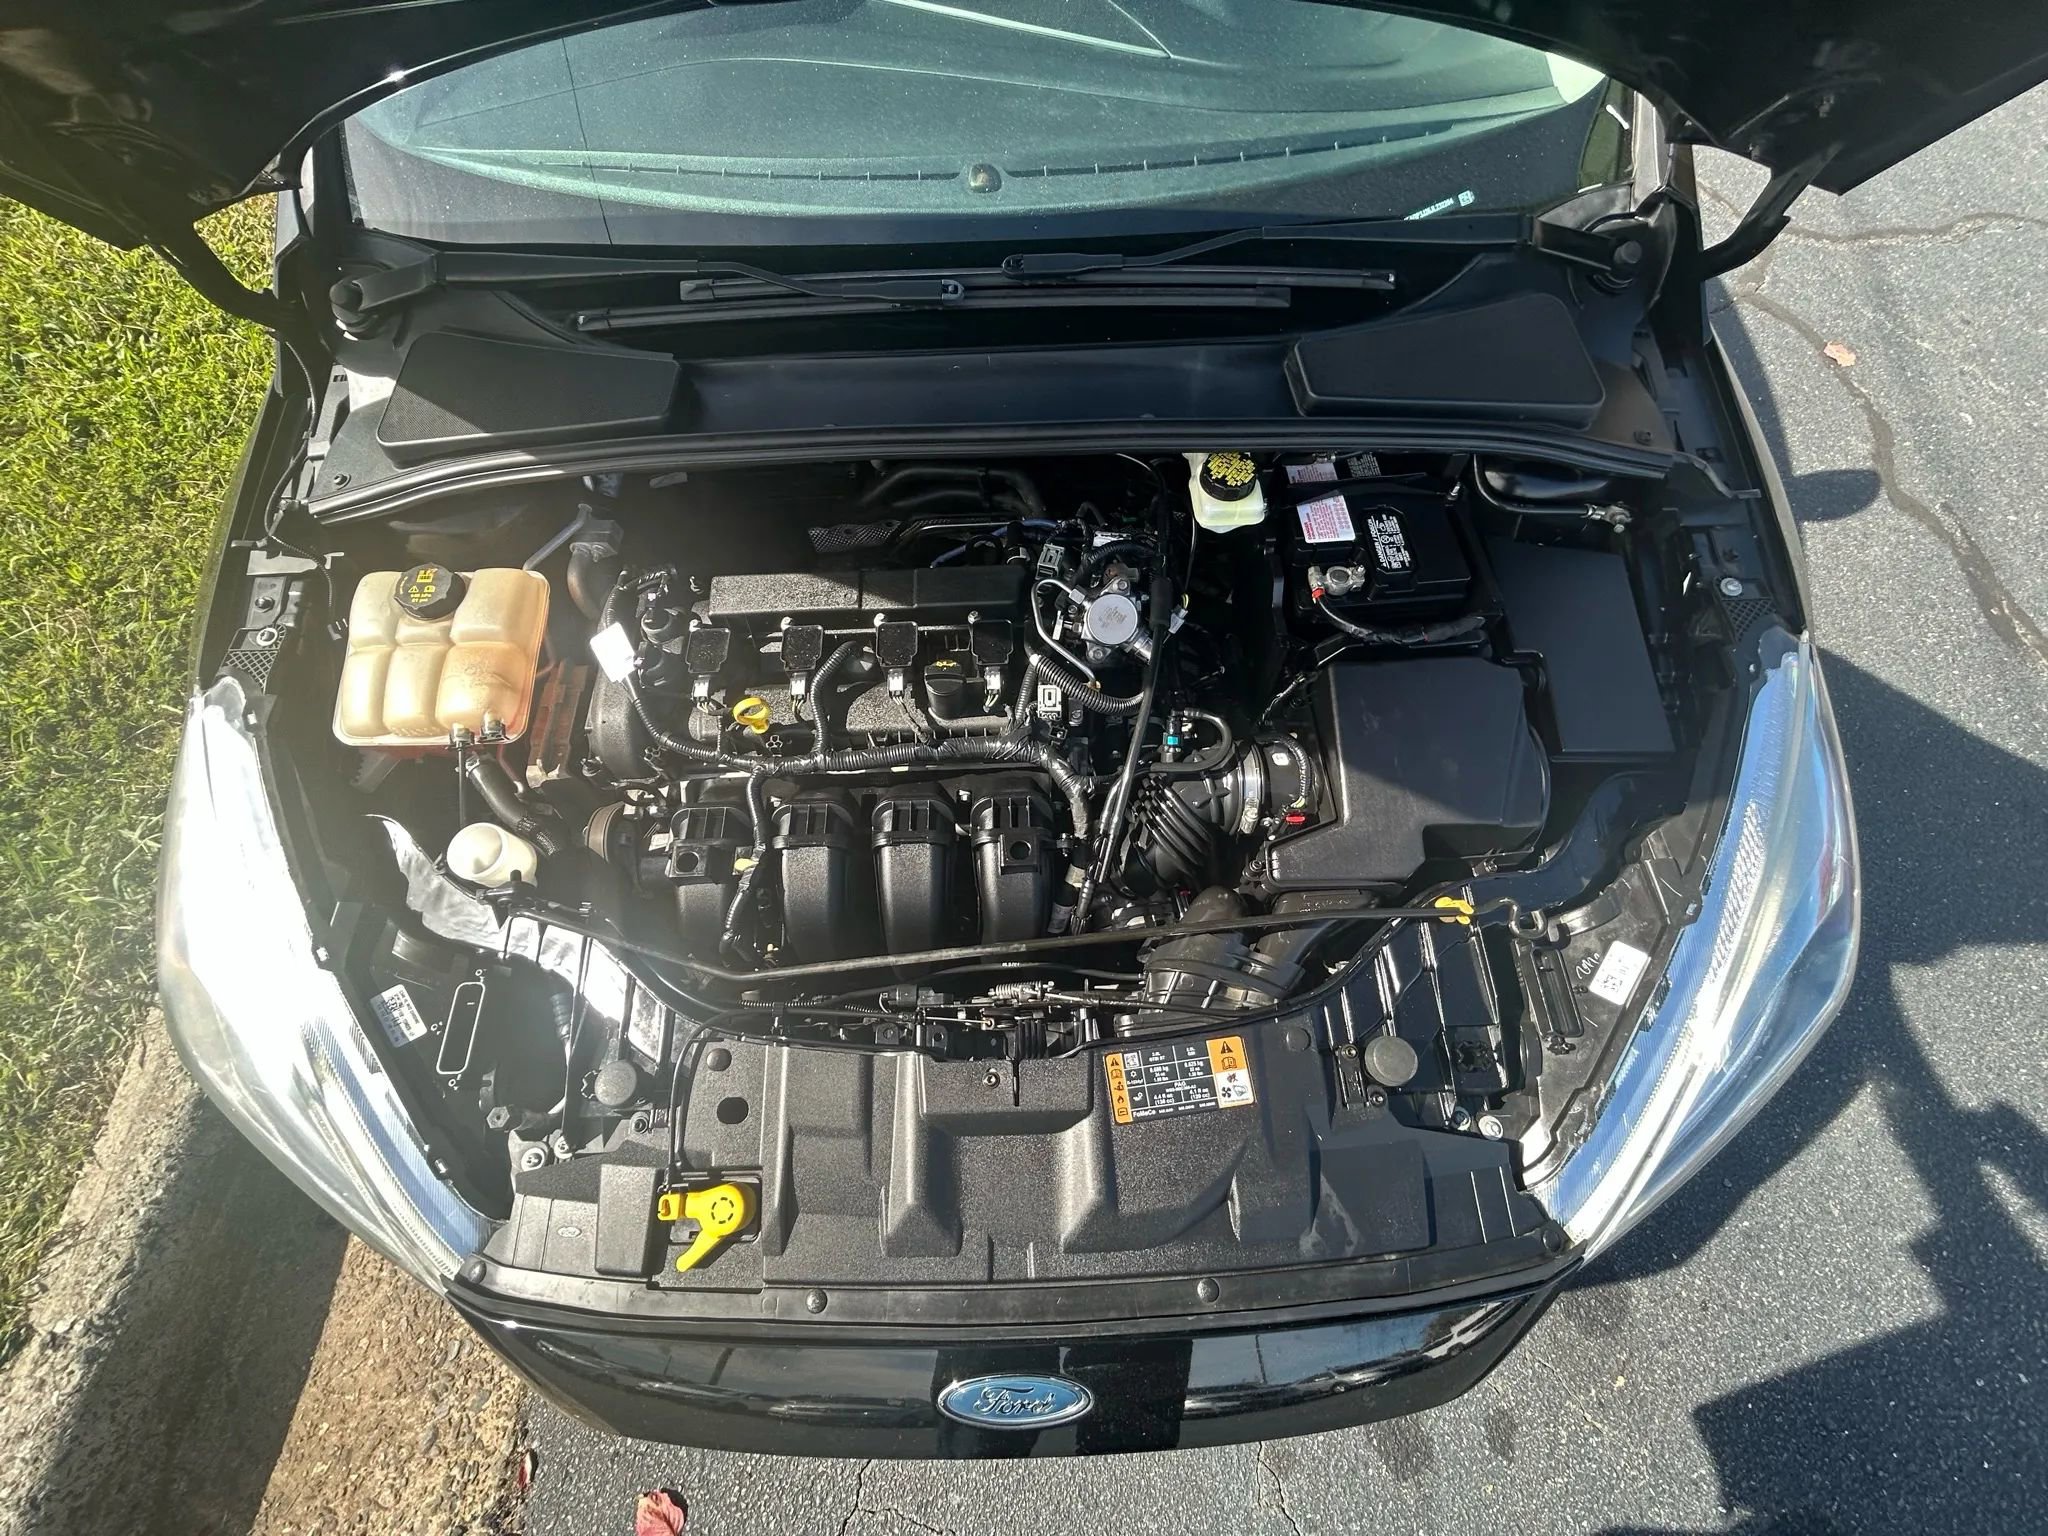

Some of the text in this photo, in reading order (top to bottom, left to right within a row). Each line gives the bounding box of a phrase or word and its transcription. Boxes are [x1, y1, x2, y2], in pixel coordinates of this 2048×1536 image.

[1367, 518, 1378, 538] POISON
[1374, 542, 1386, 563] DANGER
[972, 1386, 1056, 1416] Ford
